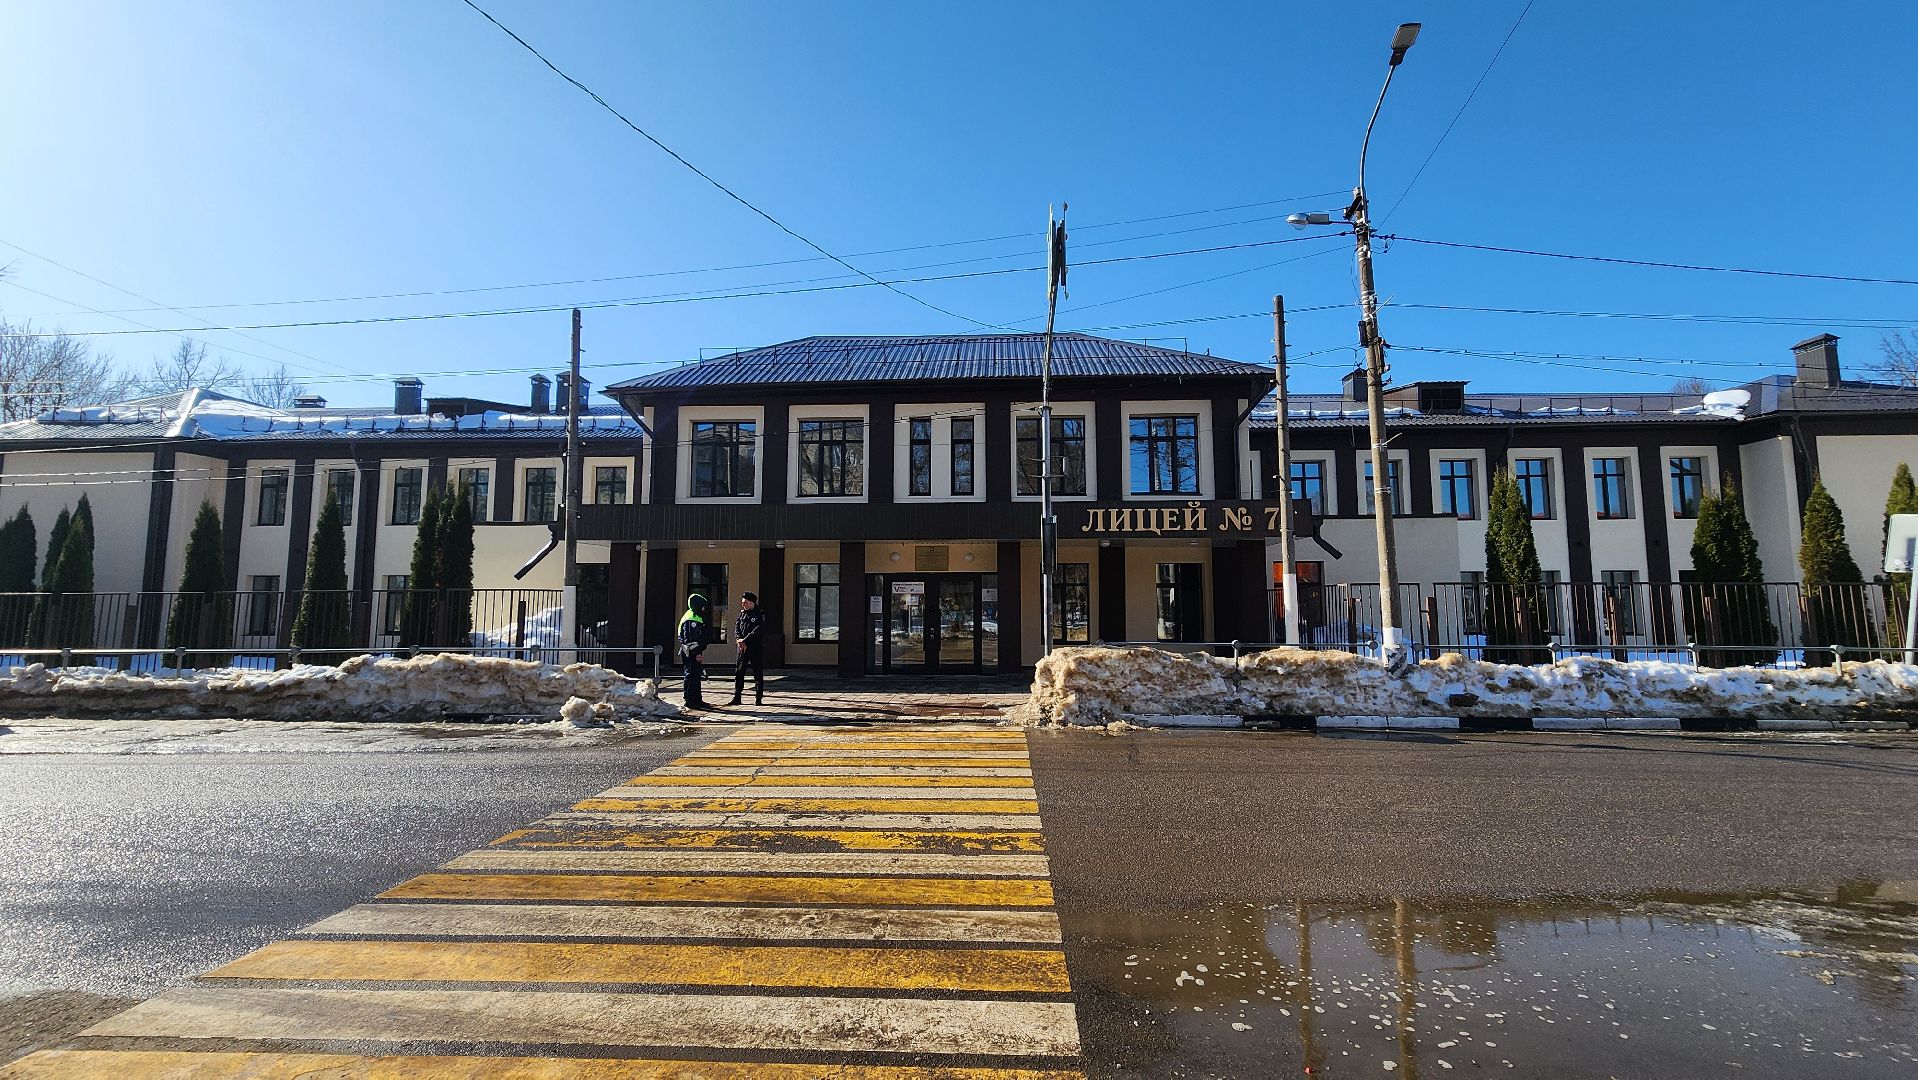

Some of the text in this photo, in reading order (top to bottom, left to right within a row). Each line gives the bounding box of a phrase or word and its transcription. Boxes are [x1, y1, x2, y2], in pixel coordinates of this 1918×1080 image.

[1082, 501, 1280, 535] ЛИЦЕЙ № 7
